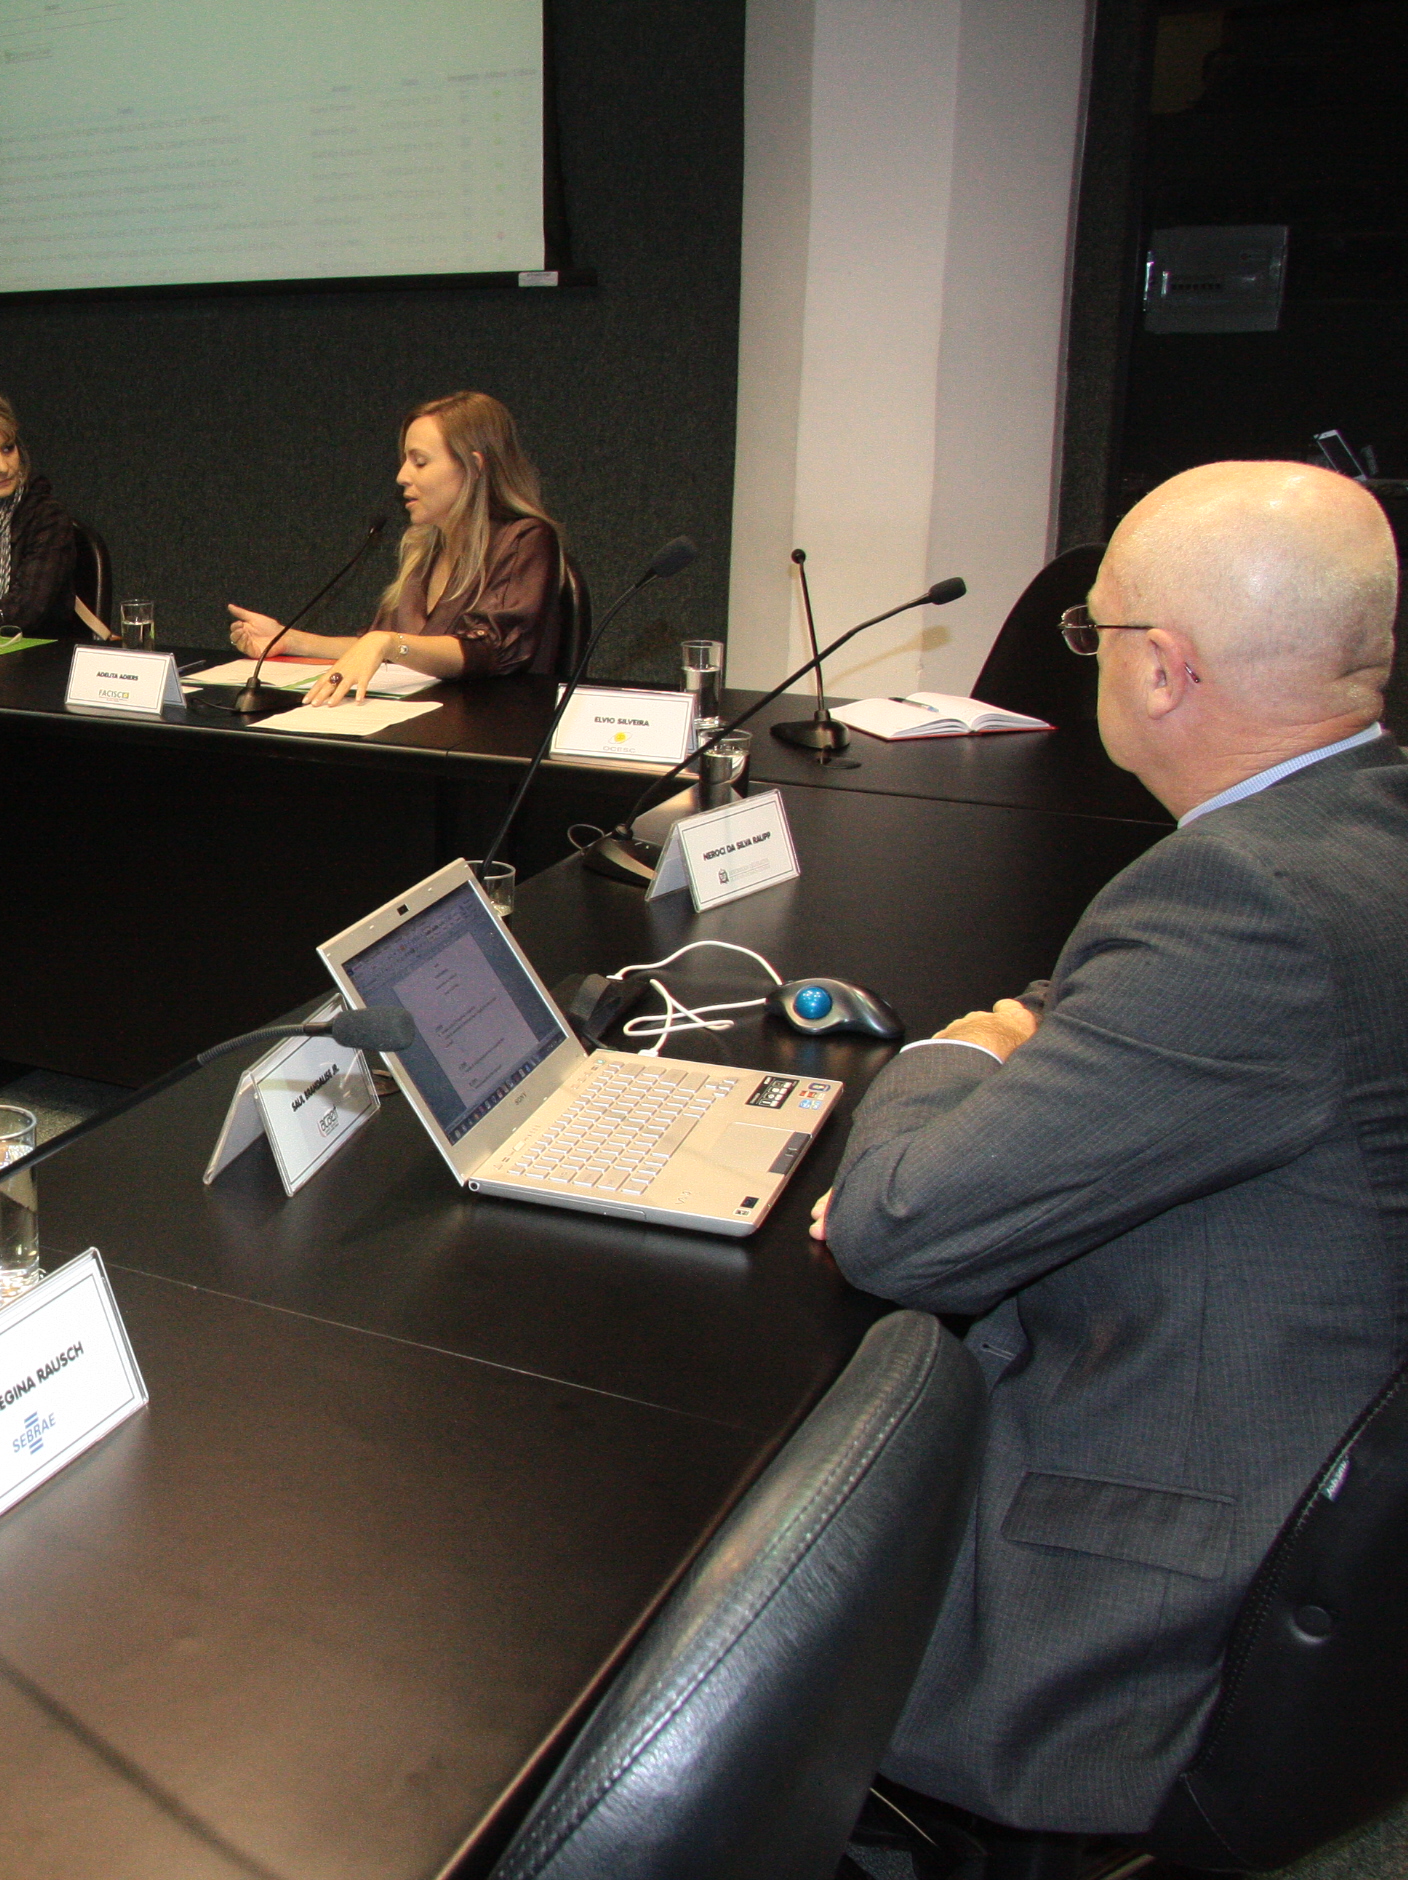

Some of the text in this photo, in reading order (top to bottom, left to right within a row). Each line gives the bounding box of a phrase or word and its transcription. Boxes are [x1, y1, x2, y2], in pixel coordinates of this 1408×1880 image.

[594, 716, 650, 727] ELVIO SILVEIRA
[726, 840, 736, 853] DA
[736, 834, 753, 850] SILVA
[36, 1340, 84, 1383] RAUSCH
[12, 1412, 56, 1453] SEBRAE
